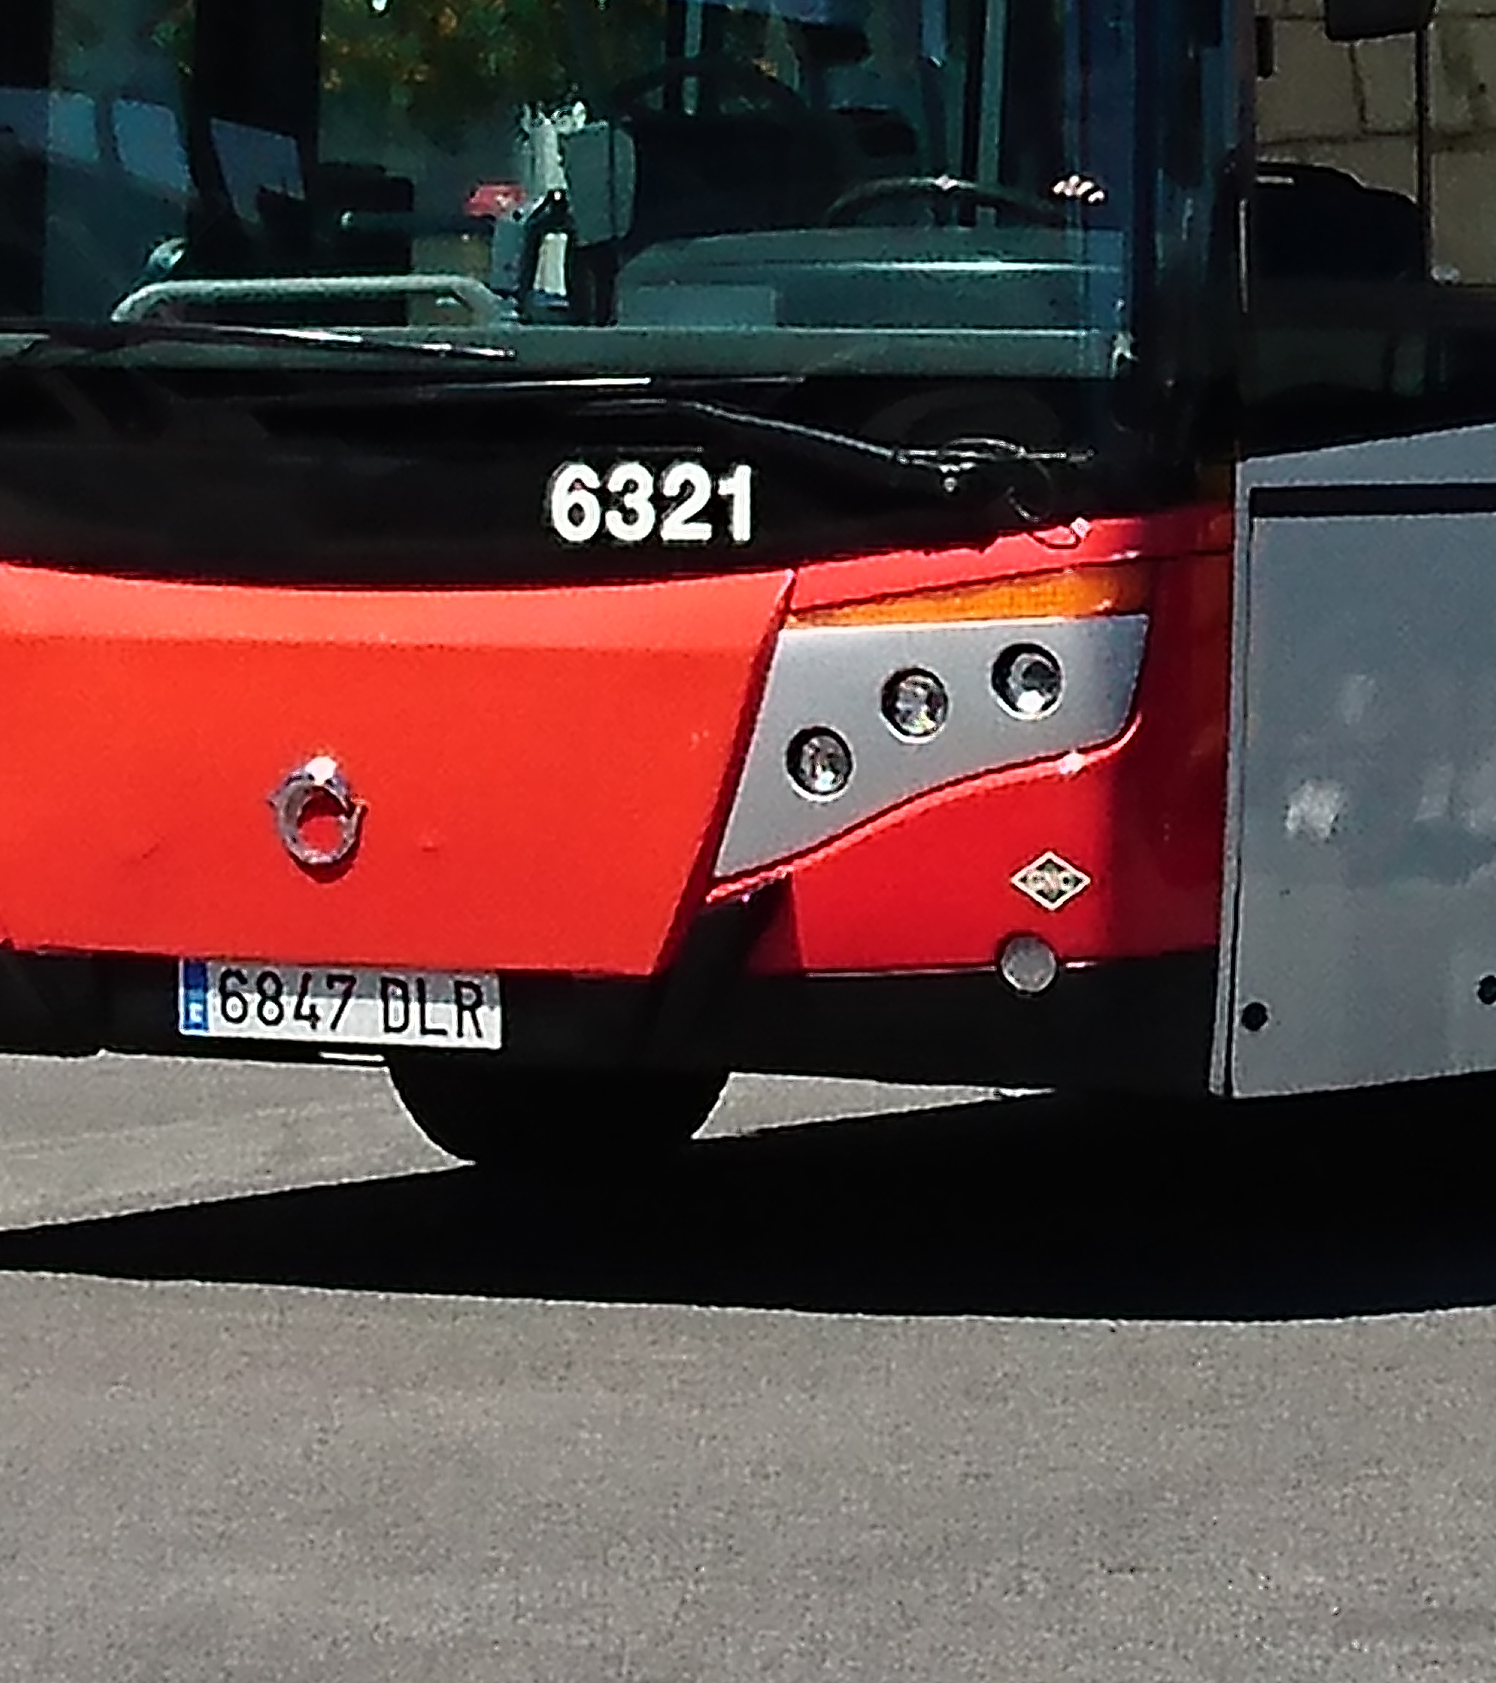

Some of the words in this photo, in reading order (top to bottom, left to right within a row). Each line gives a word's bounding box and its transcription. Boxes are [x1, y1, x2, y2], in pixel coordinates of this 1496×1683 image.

[551, 461, 752, 542] 6321
[219, 968, 357, 1031] 6847
[380, 976, 484, 1039] DLR
